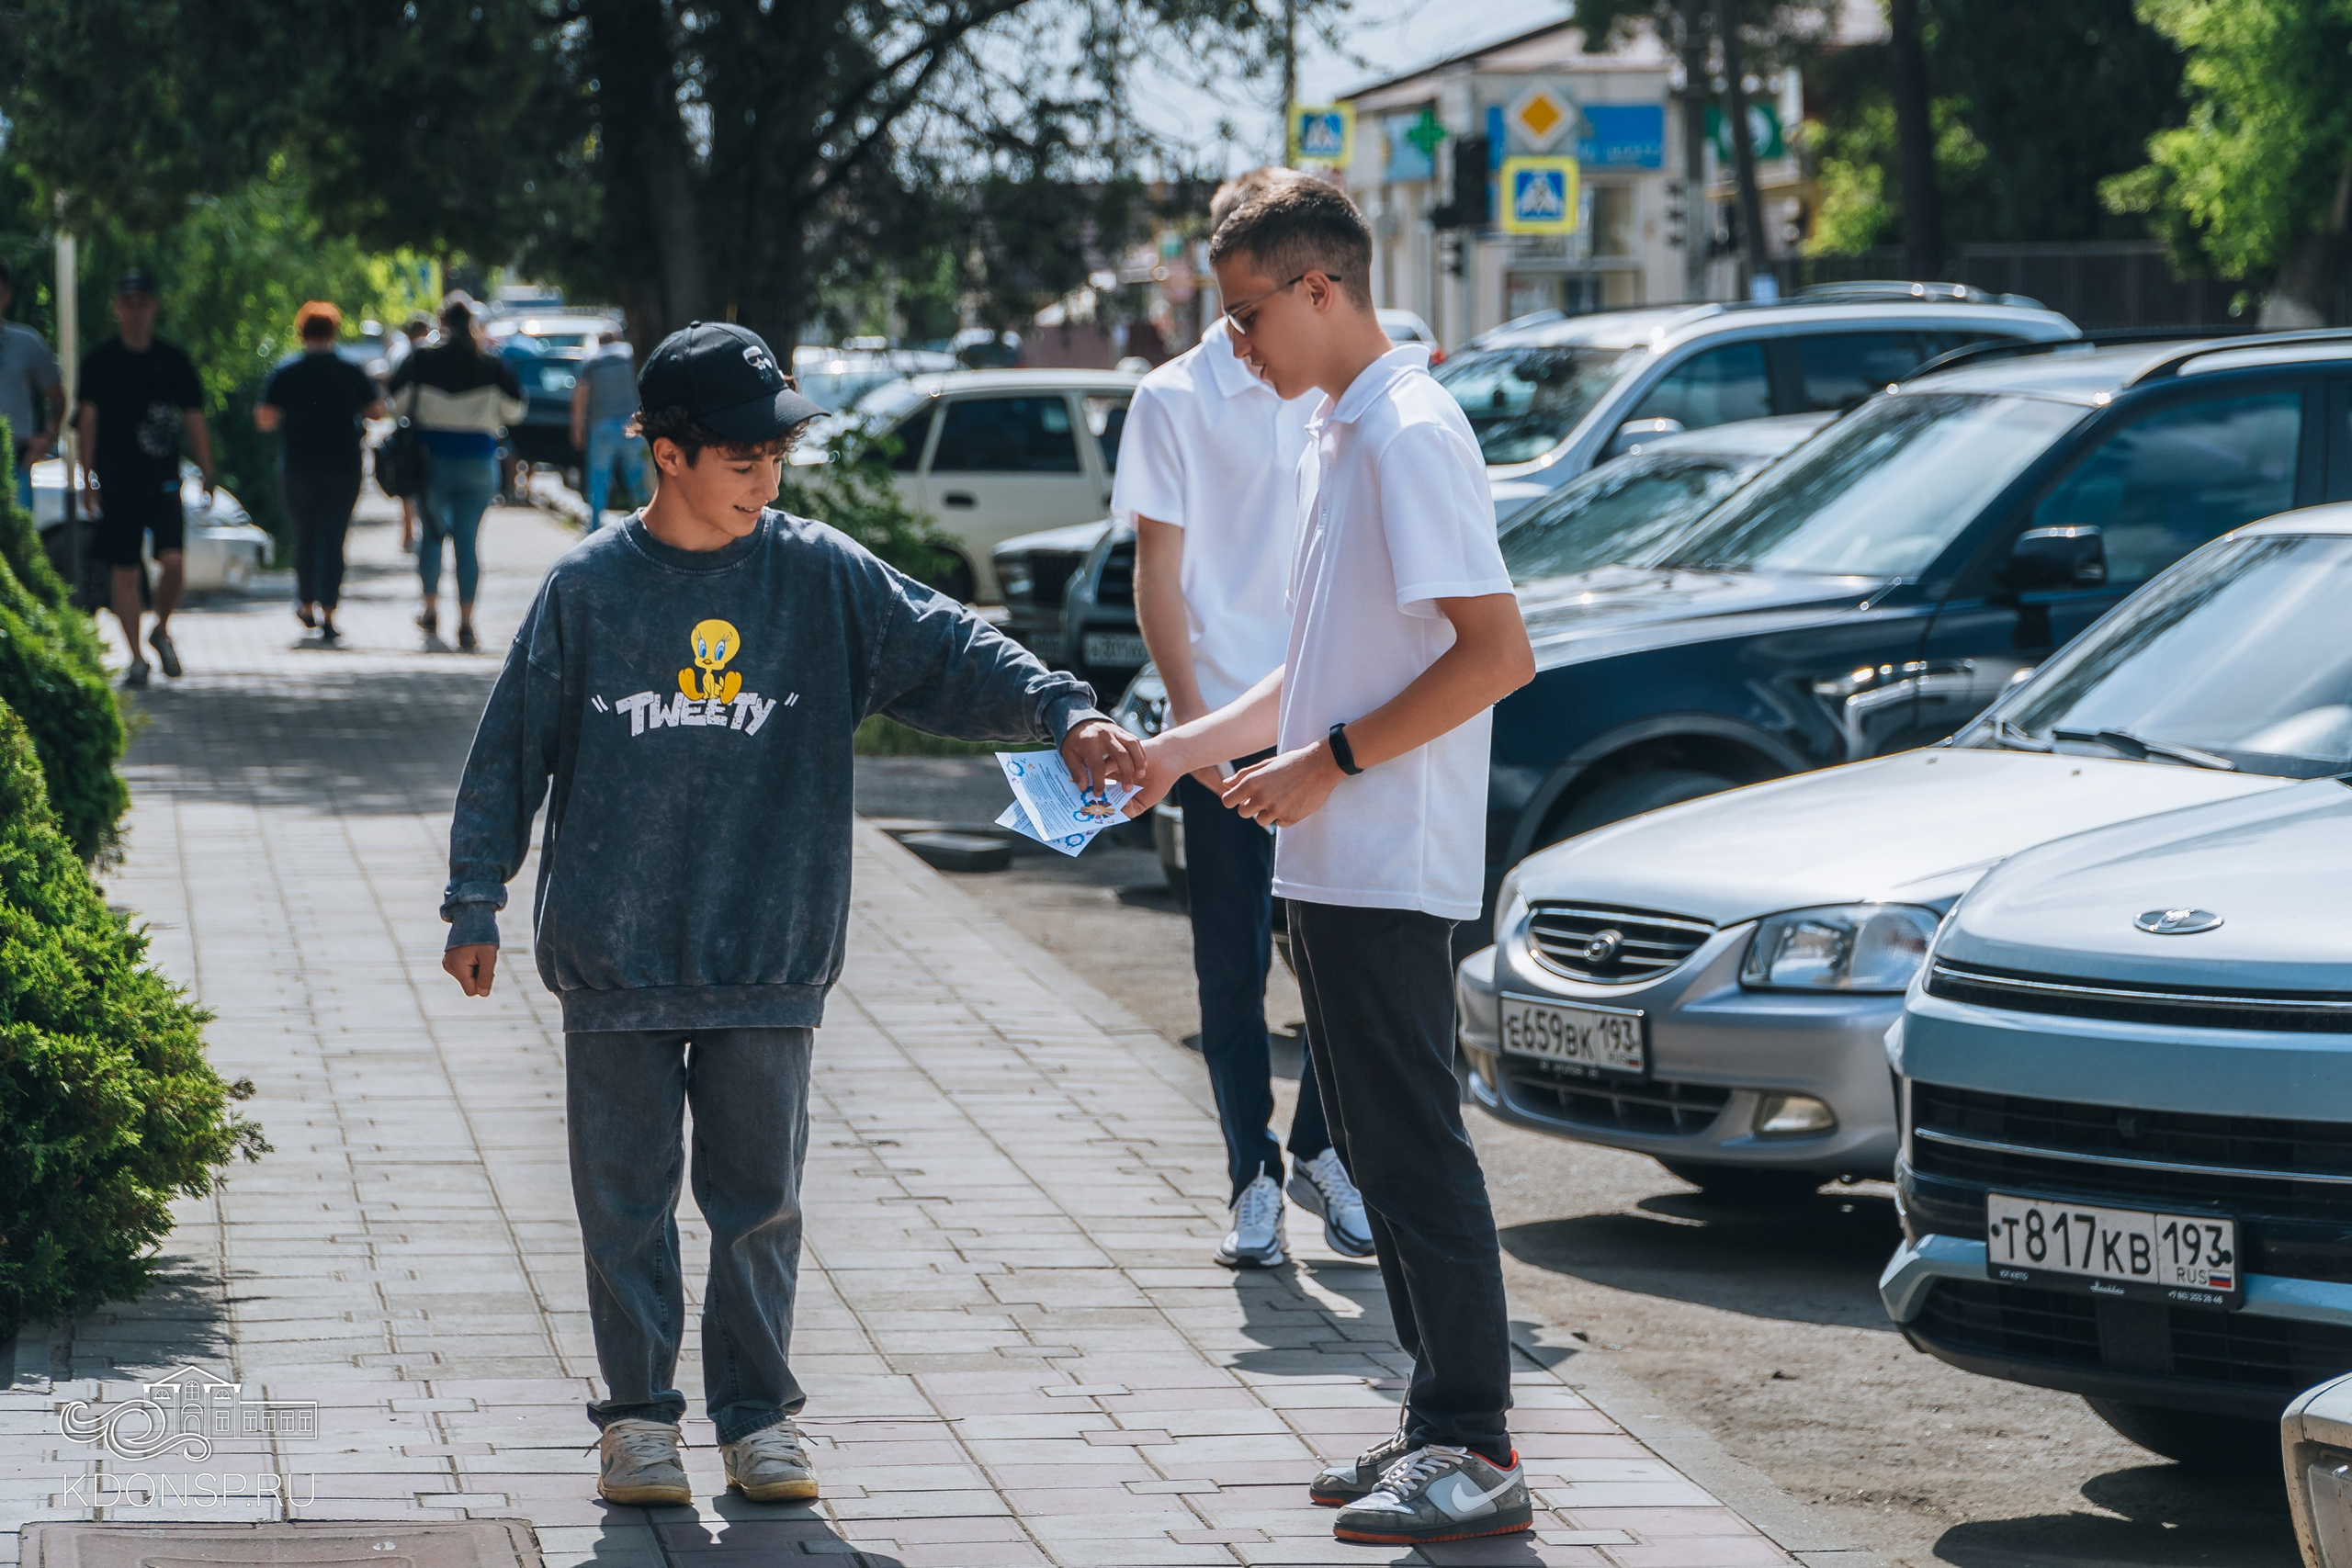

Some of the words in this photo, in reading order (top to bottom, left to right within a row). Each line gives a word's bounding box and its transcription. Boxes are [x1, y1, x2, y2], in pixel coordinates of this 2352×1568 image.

[1598, 1017, 1635, 1052] 193
[2162, 1221, 2224, 1268] 193
[2177, 1267, 2208, 1285] RUS
